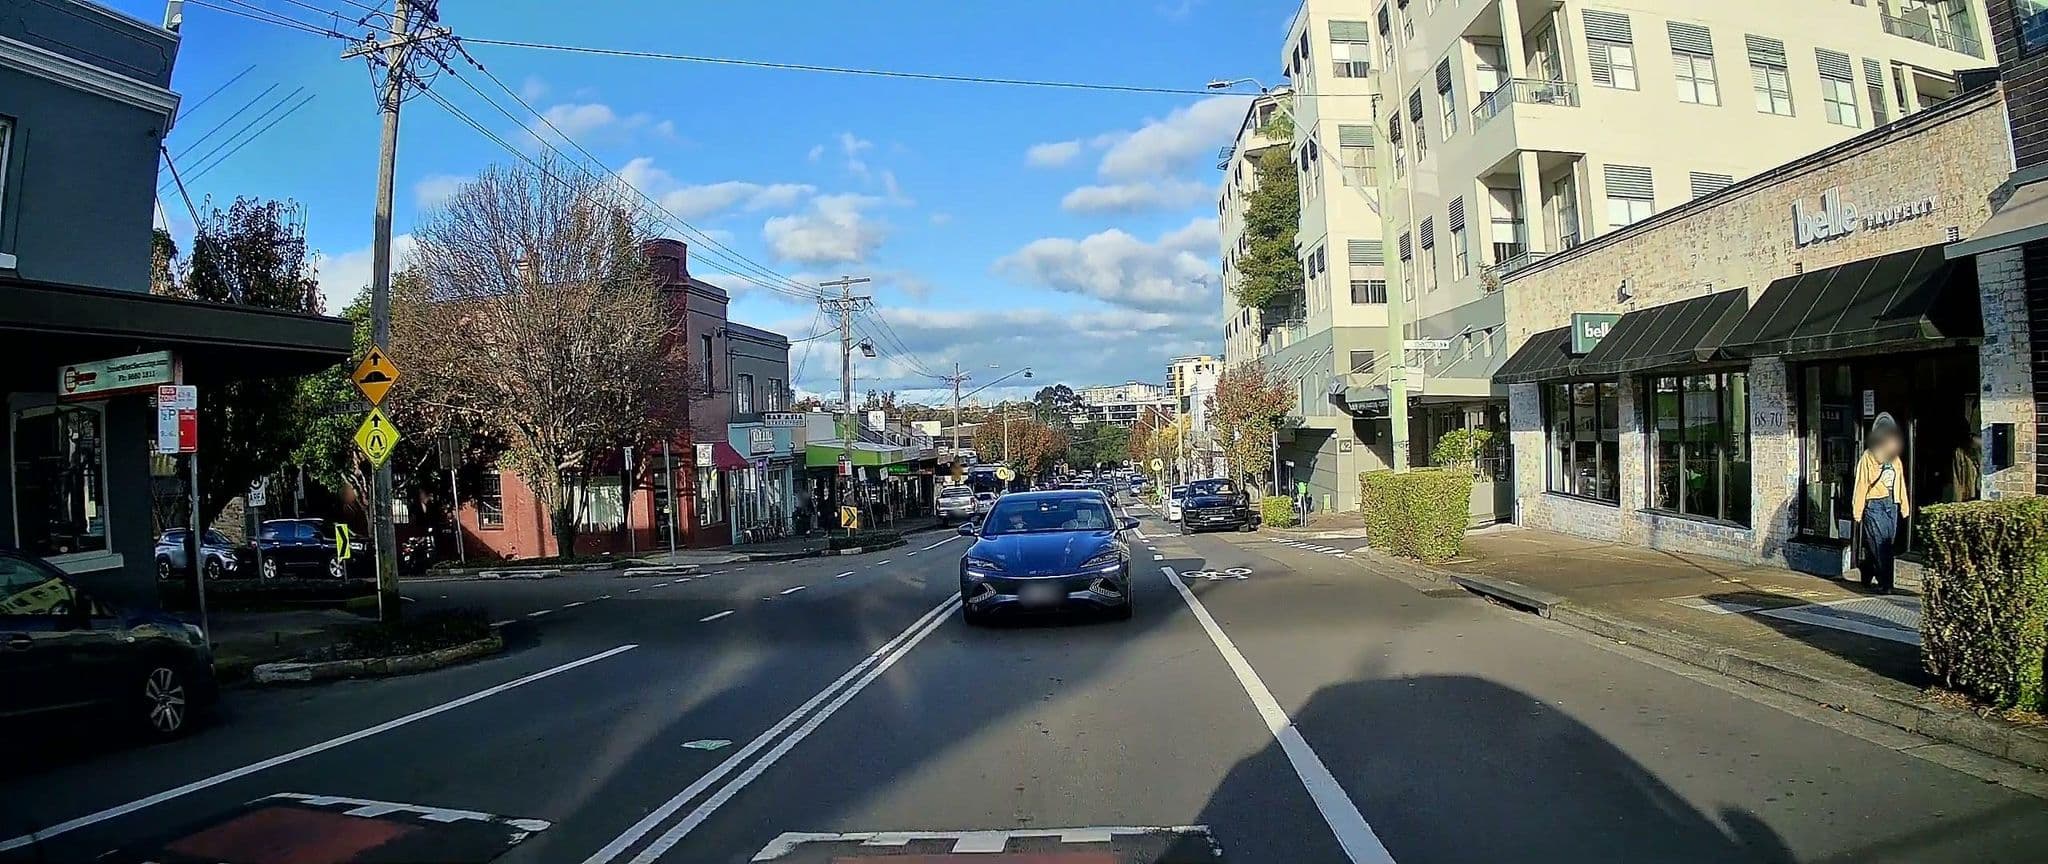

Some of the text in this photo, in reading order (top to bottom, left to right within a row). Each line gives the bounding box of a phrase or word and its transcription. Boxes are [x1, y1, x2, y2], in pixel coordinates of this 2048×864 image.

[1793, 187, 1938, 248] belle PROPERTY
[1585, 321, 1611, 338] bell
